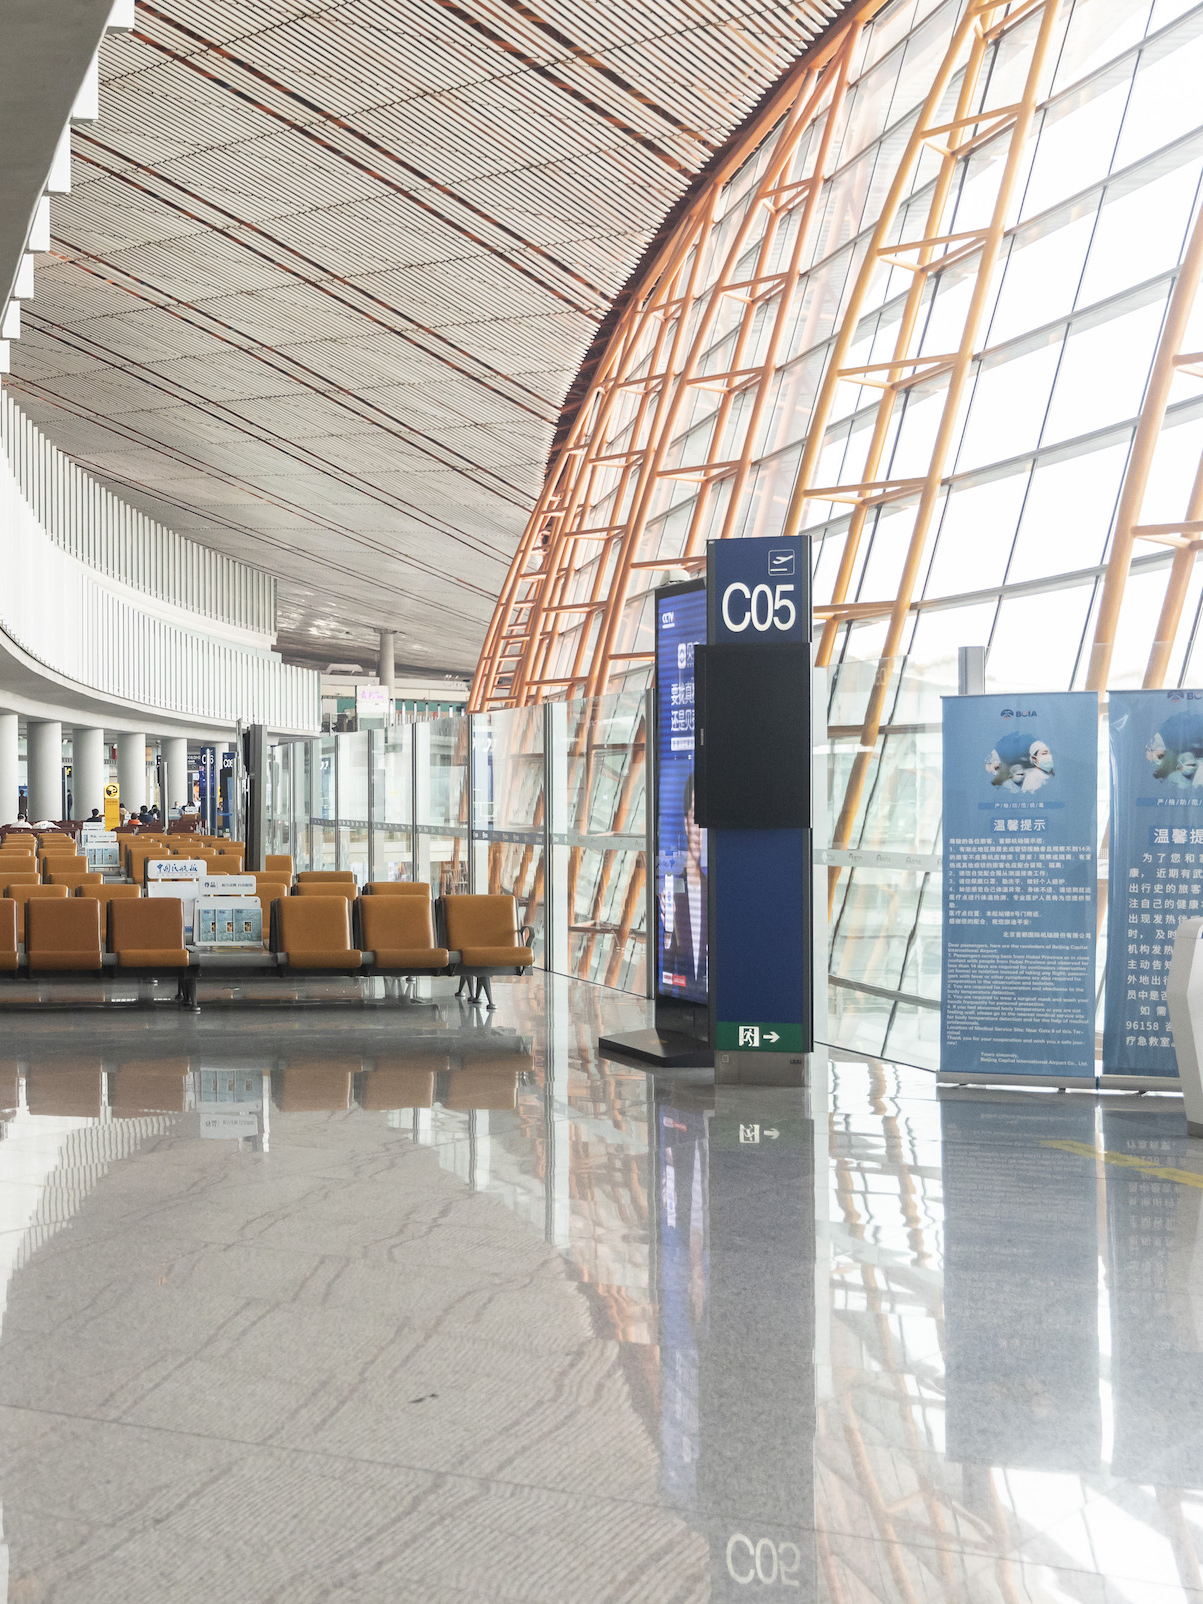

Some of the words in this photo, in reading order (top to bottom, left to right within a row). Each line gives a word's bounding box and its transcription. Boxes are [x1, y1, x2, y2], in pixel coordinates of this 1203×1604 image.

[722, 582, 796, 633] C05
[1015, 710, 1038, 718] BCIA
[671, 709, 695, 732] 还是贝
[993, 818, 1046, 832] 温馨提示
[1129, 883, 1201, 895] 出行史的旅客
[1128, 899, 1203, 910] 注自己的健康
[1126, 1021, 1159, 1031] 96158
